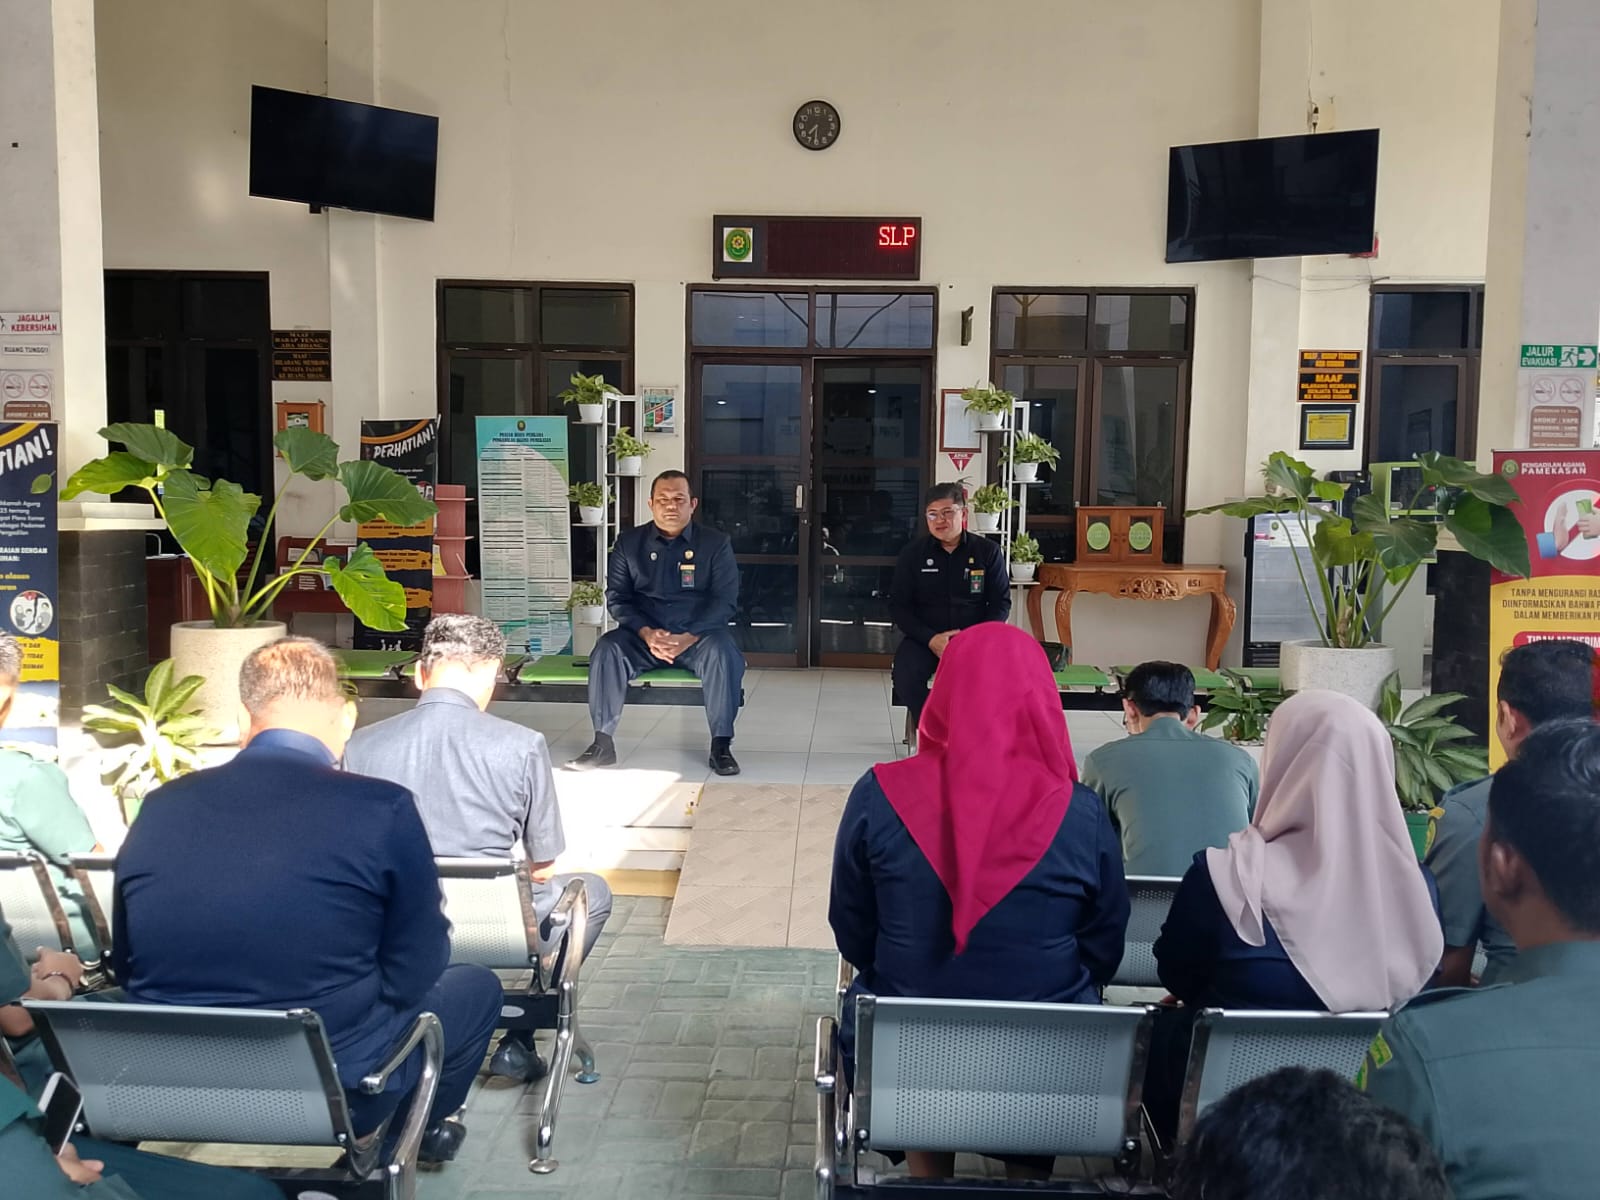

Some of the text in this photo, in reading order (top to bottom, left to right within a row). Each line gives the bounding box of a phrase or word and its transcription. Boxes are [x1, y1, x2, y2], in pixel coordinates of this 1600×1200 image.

[879, 226, 915, 246] SLP
[1526, 346, 1554, 356] JALUR
[1522, 357, 1558, 366] EVAKUASI
[1315, 374, 1343, 382] MAAF
[373, 423, 436, 459] PERHATIAN!
[1512, 588, 1536, 596] TANPA
[1539, 589, 1586, 597] MENGURANGI
[1502, 600, 1566, 608] DIINFORMASIKAN
[1568, 600, 1594, 608] BAHWA
[1514, 611, 1540, 619] DALAM
[1542, 611, 1591, 619] MEMBERIKAN
